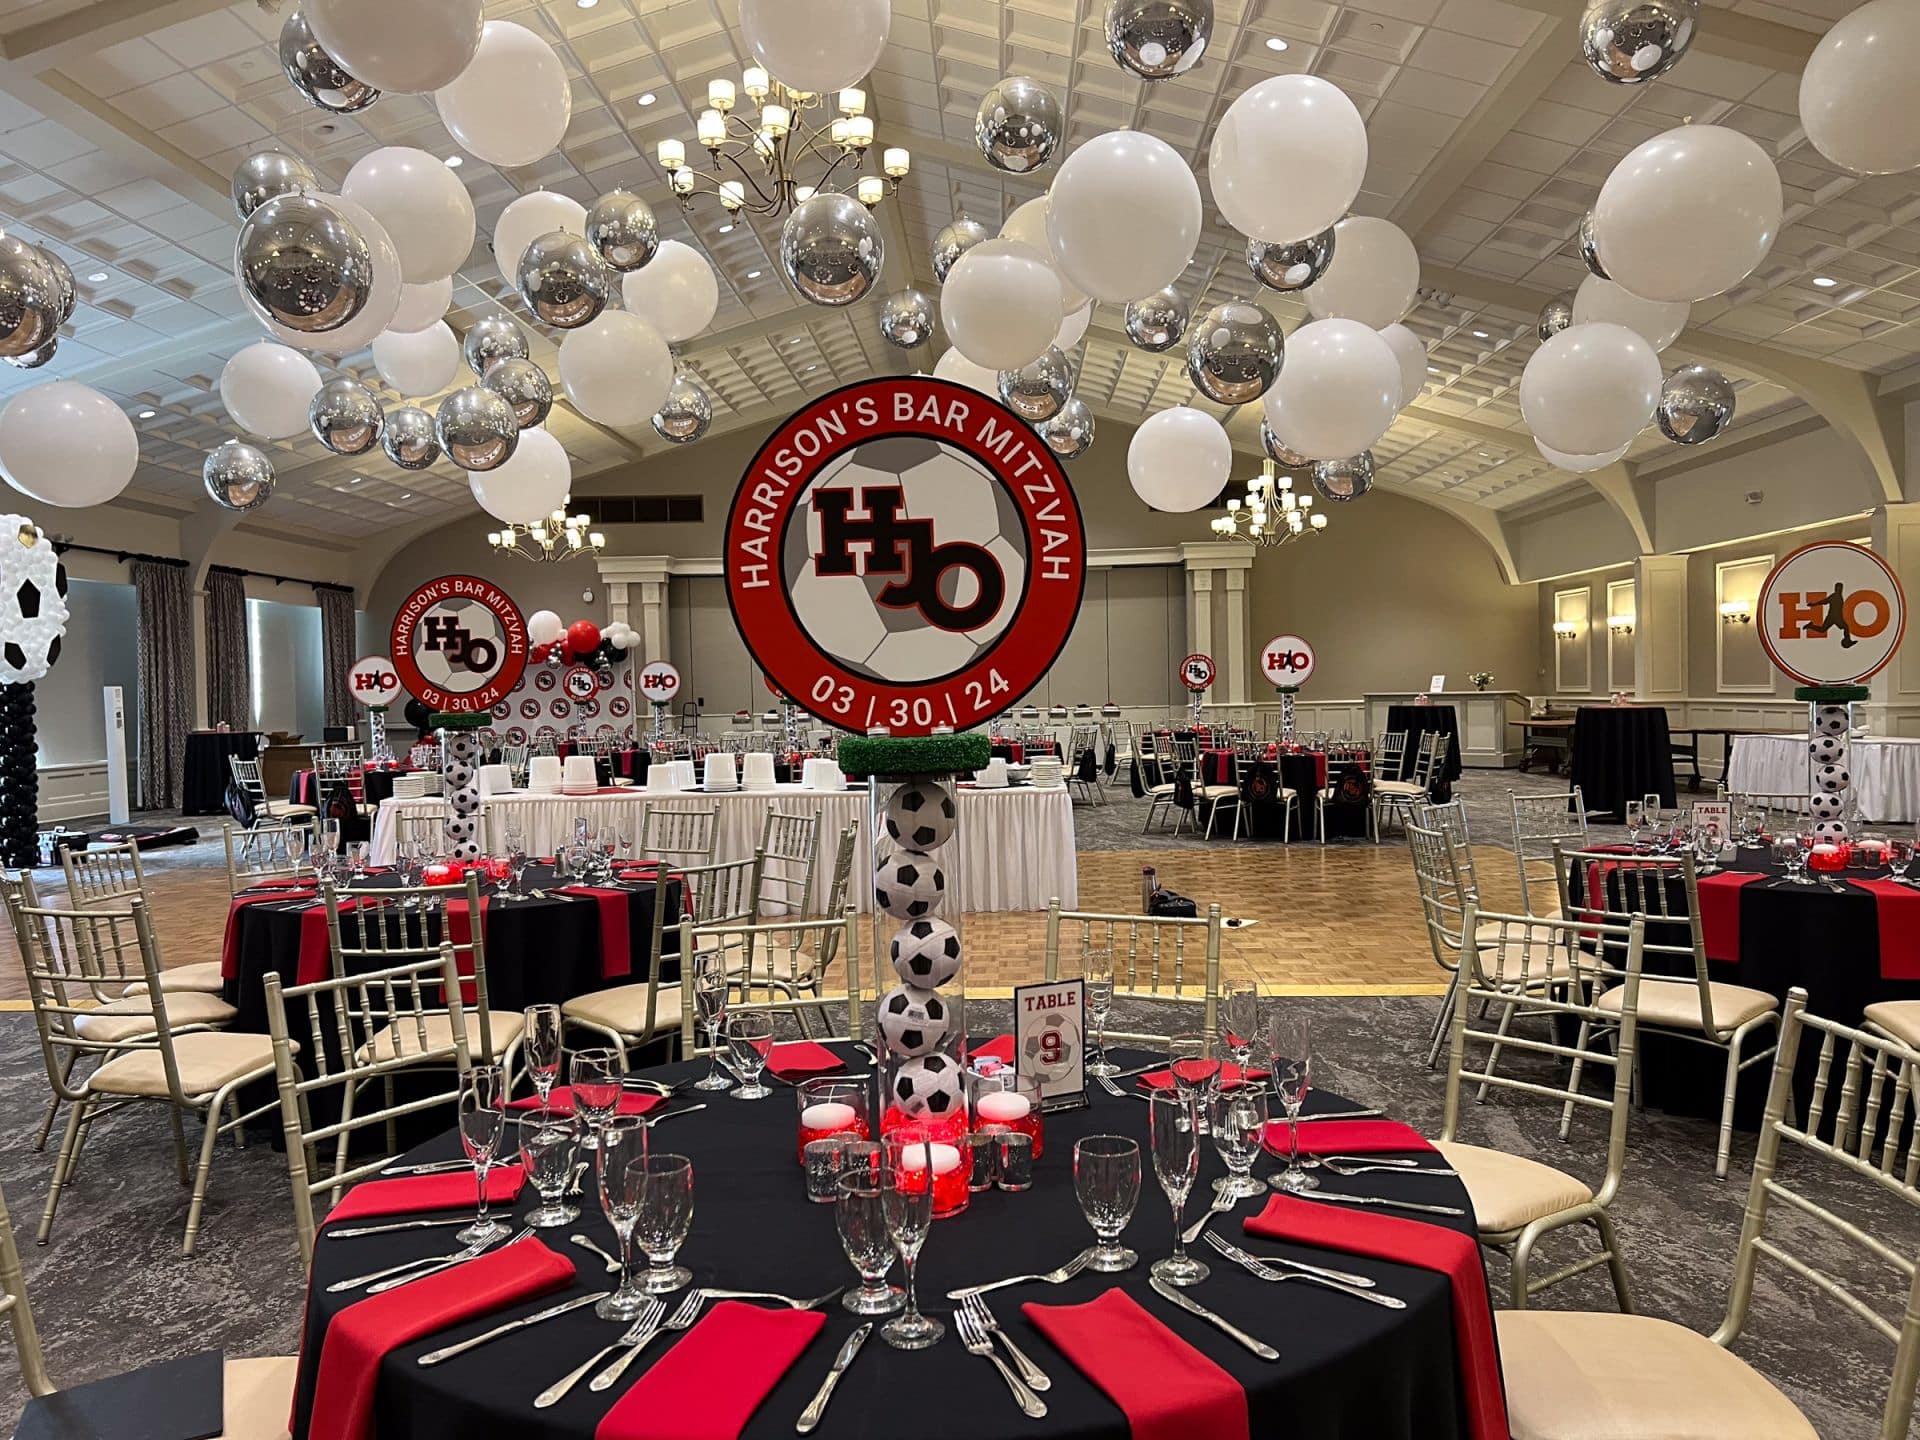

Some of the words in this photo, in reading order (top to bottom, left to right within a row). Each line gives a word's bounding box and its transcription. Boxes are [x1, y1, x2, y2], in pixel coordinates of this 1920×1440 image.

[740, 397, 879, 589] HARRISON'S
[893, 392, 970, 432] BAR
[975, 417, 1071, 580] MITZVAH
[812, 485, 1006, 633] HJO
[396, 582, 450, 656] HARRISON'S
[455, 580, 484, 596] BAR
[486, 591, 523, 654] MITZVAH
[422, 688, 440, 704] 03
[452, 699, 469, 710] 30
[481, 687, 499, 704] 24
[811, 675, 856, 714] 03
[889, 698, 932, 727] 30
[965, 667, 1010, 711] 24
[1697, 806, 1728, 814] TABLE
[1024, 991, 1077, 1012] TABLE
[1040, 1030, 1062, 1065] 9
